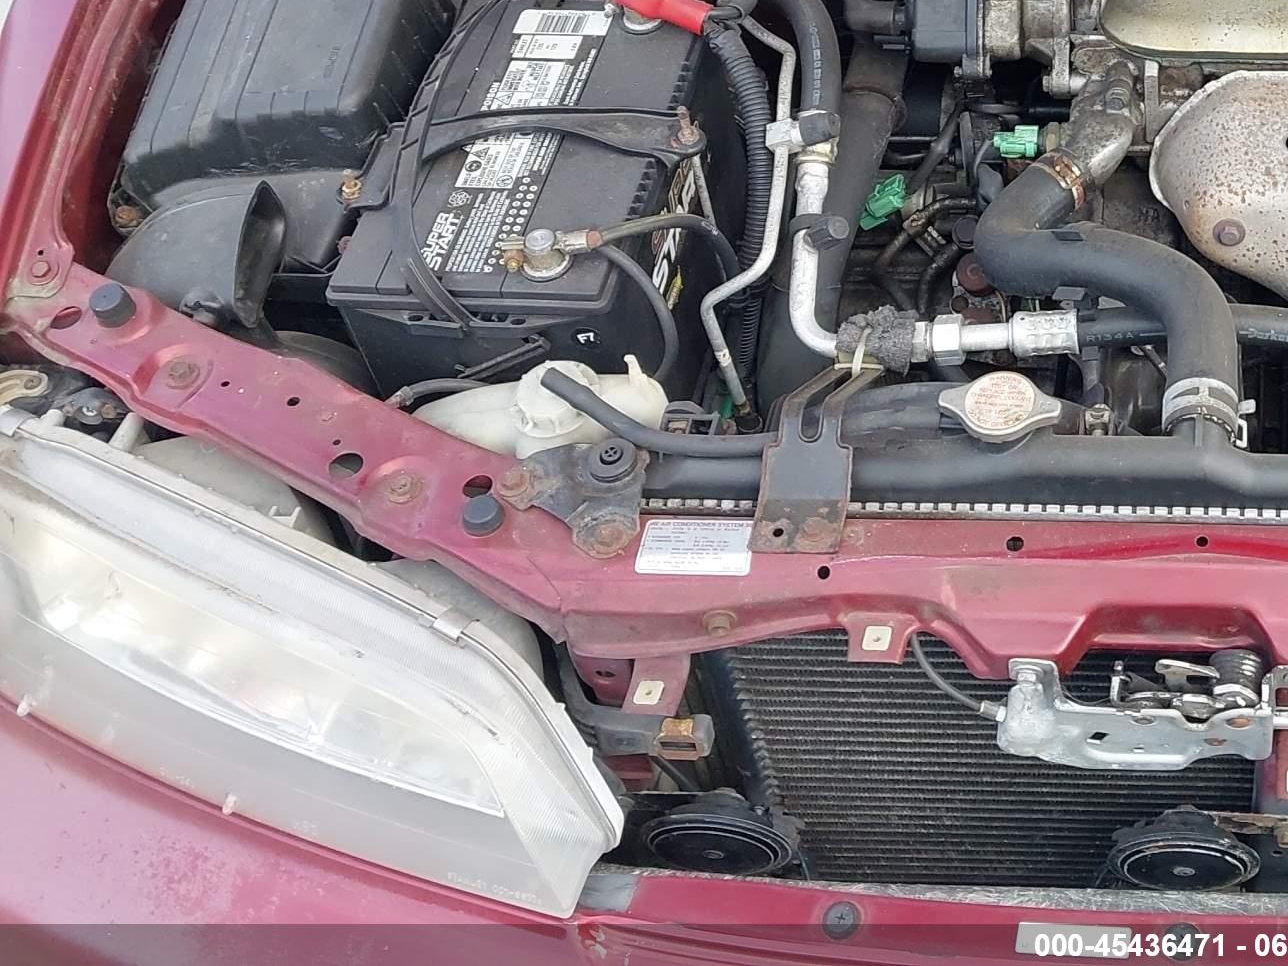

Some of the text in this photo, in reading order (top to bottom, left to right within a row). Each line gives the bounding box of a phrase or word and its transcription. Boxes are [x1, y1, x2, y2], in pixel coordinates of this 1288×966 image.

[480, 81, 501, 111] POISON
[421, 212, 450, 267] SUPER
[429, 213, 460, 271] START
[1086, 331, 1136, 343] R134A
